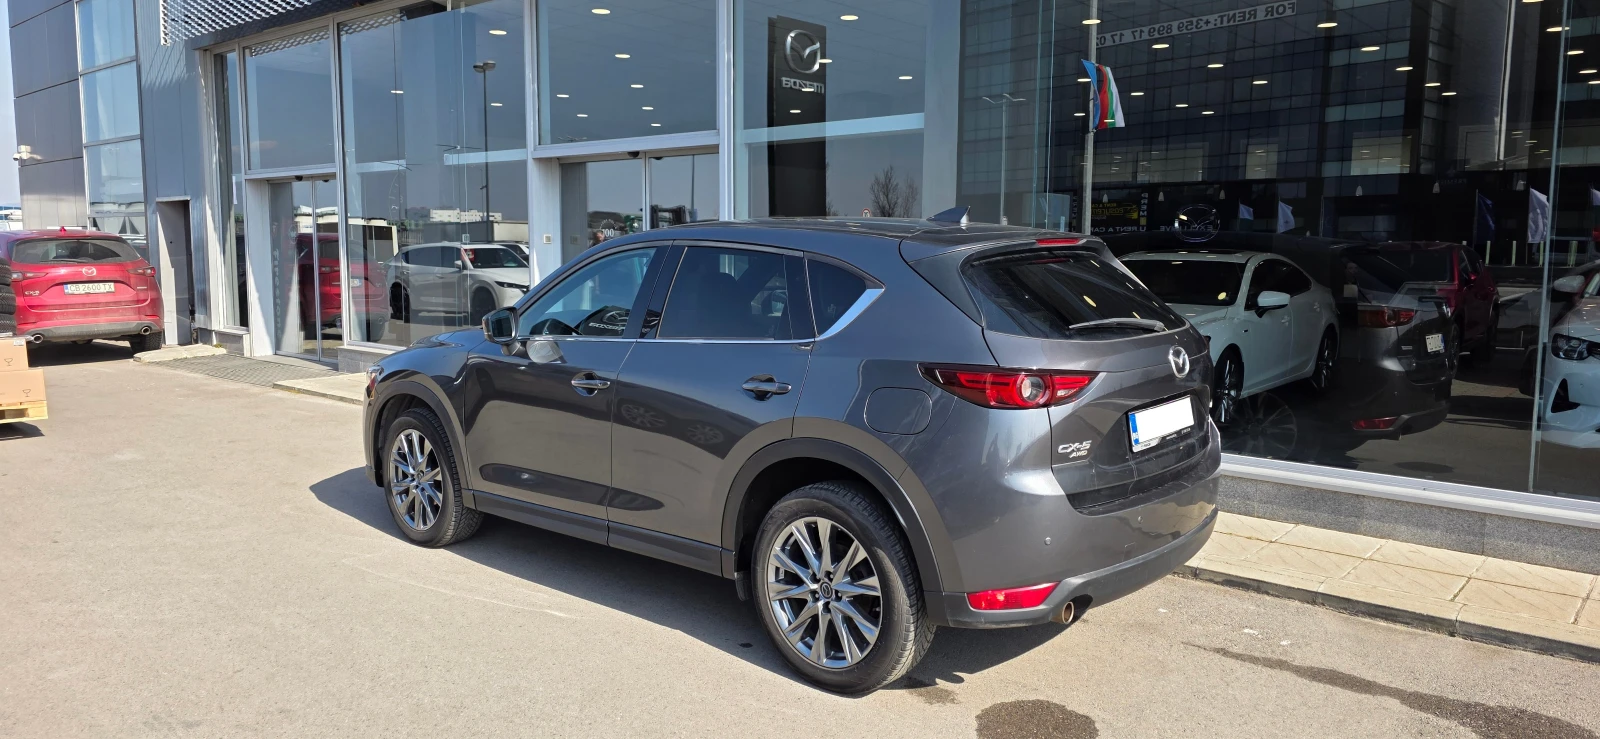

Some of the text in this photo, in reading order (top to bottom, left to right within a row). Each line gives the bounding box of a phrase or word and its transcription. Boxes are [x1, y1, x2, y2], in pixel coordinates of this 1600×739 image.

[82, 283, 101, 291] 2600
[103, 283, 113, 291] TX
[1057, 440, 1092, 453] CX-5
[1069, 450, 1088, 458] AWD
